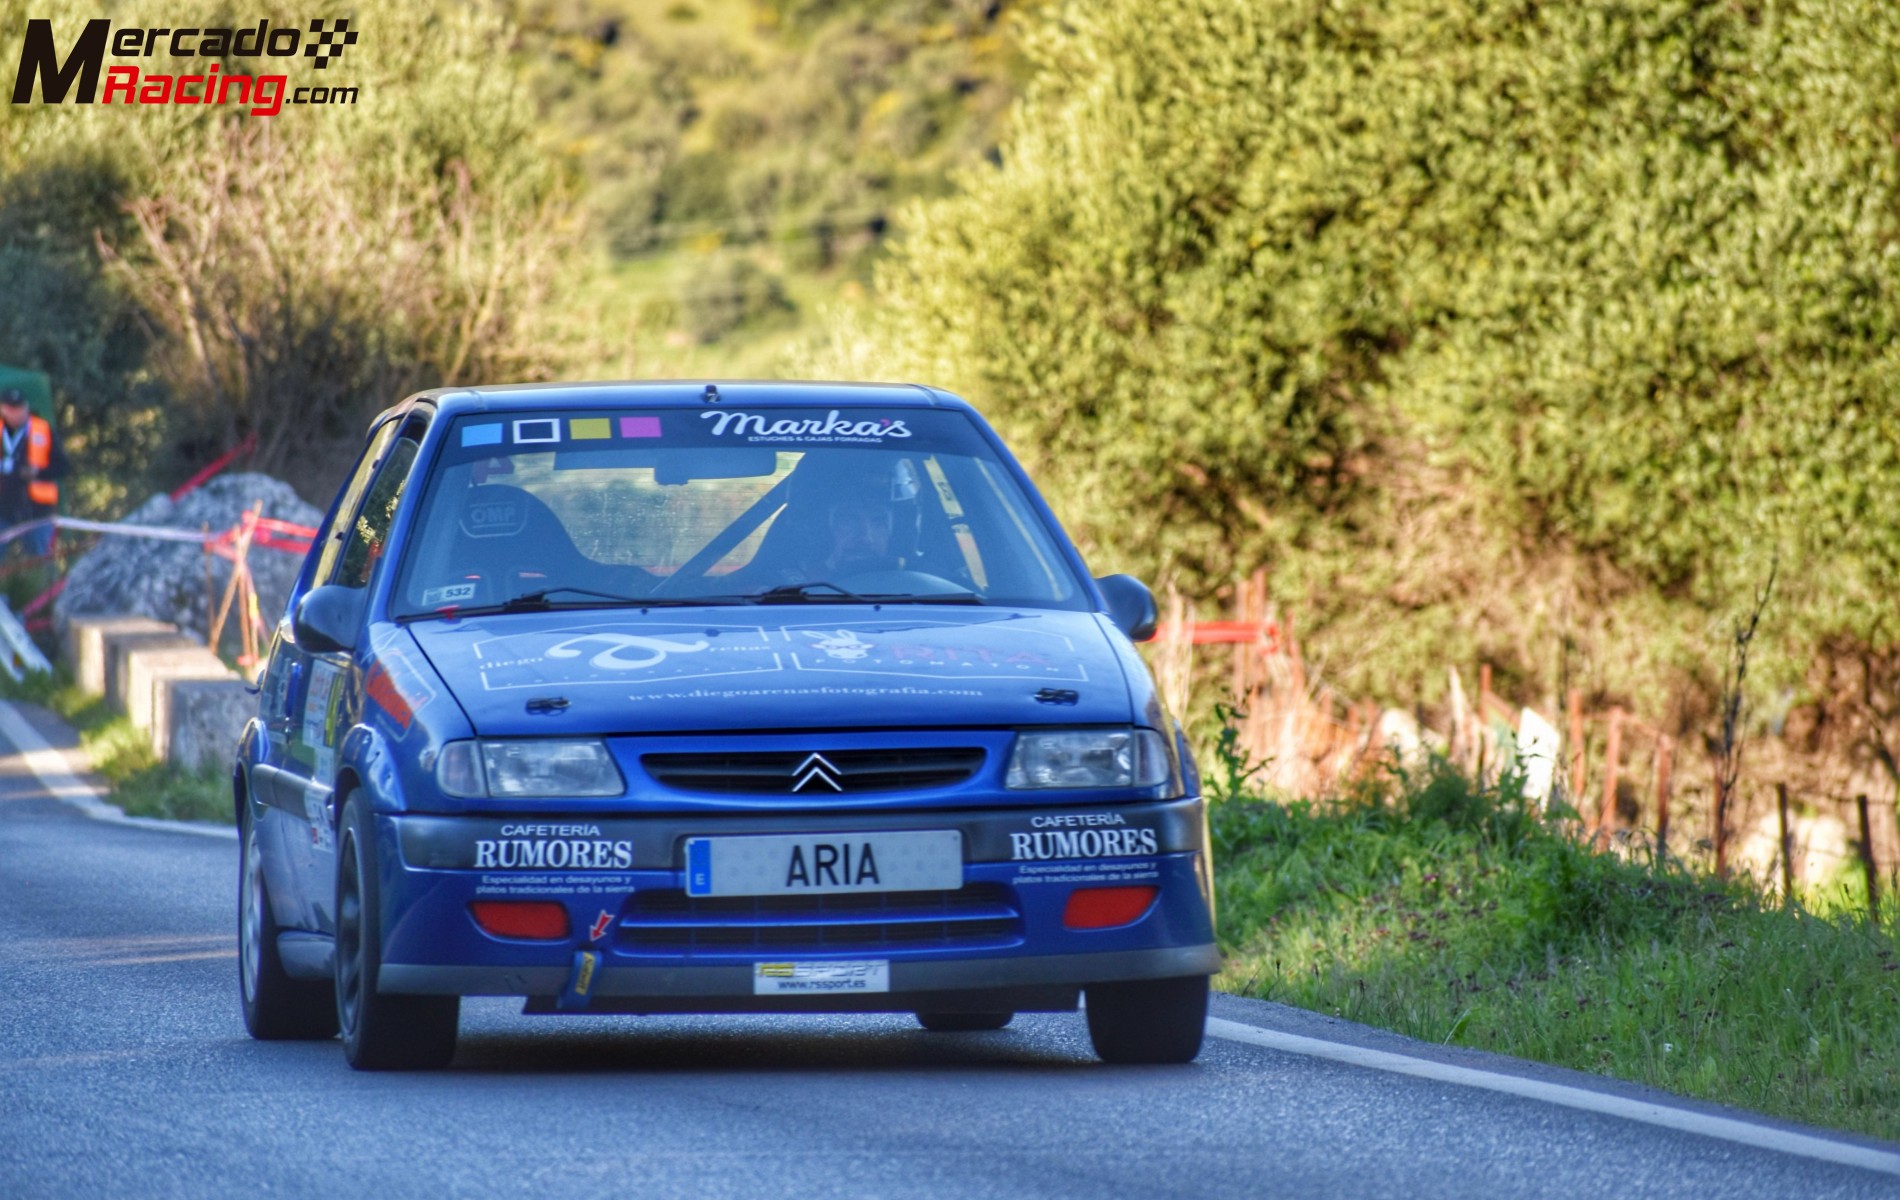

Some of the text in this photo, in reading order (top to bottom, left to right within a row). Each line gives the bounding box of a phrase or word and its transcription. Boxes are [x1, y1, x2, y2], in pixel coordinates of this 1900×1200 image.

[446, 587, 471, 597] 532
[628, 685, 984, 701] www.diegoarenasfotografia.com
[1031, 812, 1126, 828] CAFETERÍA
[500, 824, 600, 837] CAFETERÍA
[1009, 828, 1159, 860] RUMORES
[474, 839, 633, 868] RUMORES
[695, 843, 880, 887] E ARIA
[1019, 864, 1082, 874] Especialidad
[1098, 863, 1149, 872] desayunos
[1150, 862, 1157, 870] y
[482, 875, 548, 884] Especialidad
[565, 875, 622, 885] desayunos
[624, 876, 632, 884] y
[1012, 876, 1043, 885] platos
[1044, 874, 1105, 883] tradicionales
[1133, 871, 1159, 879] sierra
[475, 885, 507, 895] platos
[509, 885, 574, 894] tradicionales
[576, 886, 591, 894] de
[605, 885, 635, 894] sierra
[778, 979, 866, 990] www.rssport.es
